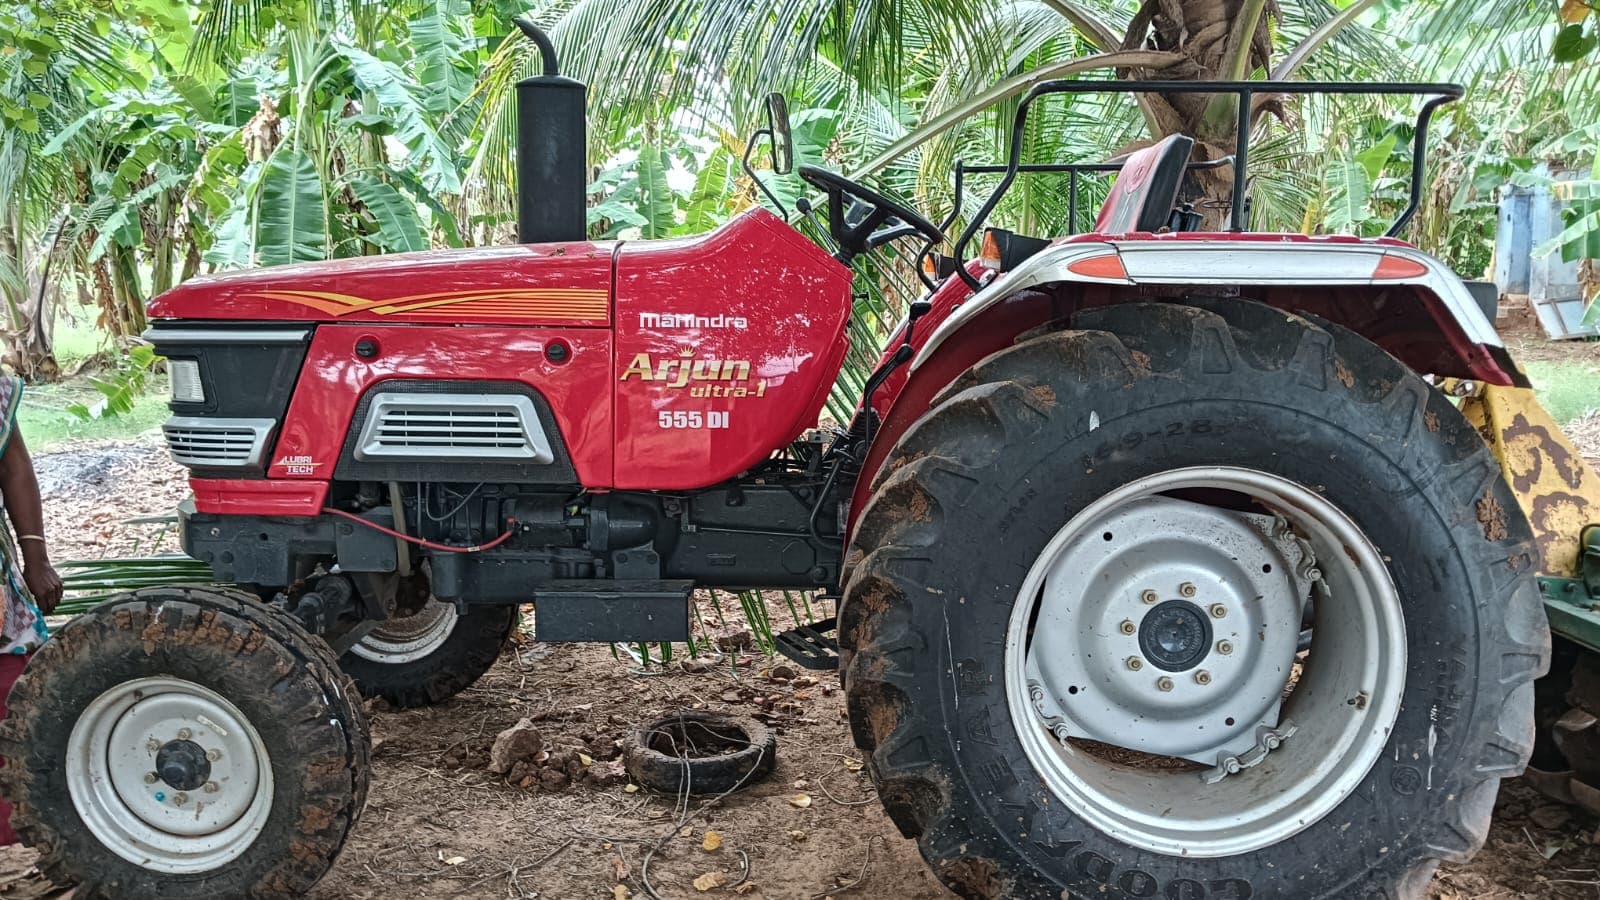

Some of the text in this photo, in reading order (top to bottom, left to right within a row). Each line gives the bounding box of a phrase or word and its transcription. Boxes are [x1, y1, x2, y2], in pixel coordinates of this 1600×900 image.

[620, 346, 751, 388] Arjun
[659, 411, 729, 429] 555 DI
[284, 455, 313, 464] LUBRI
